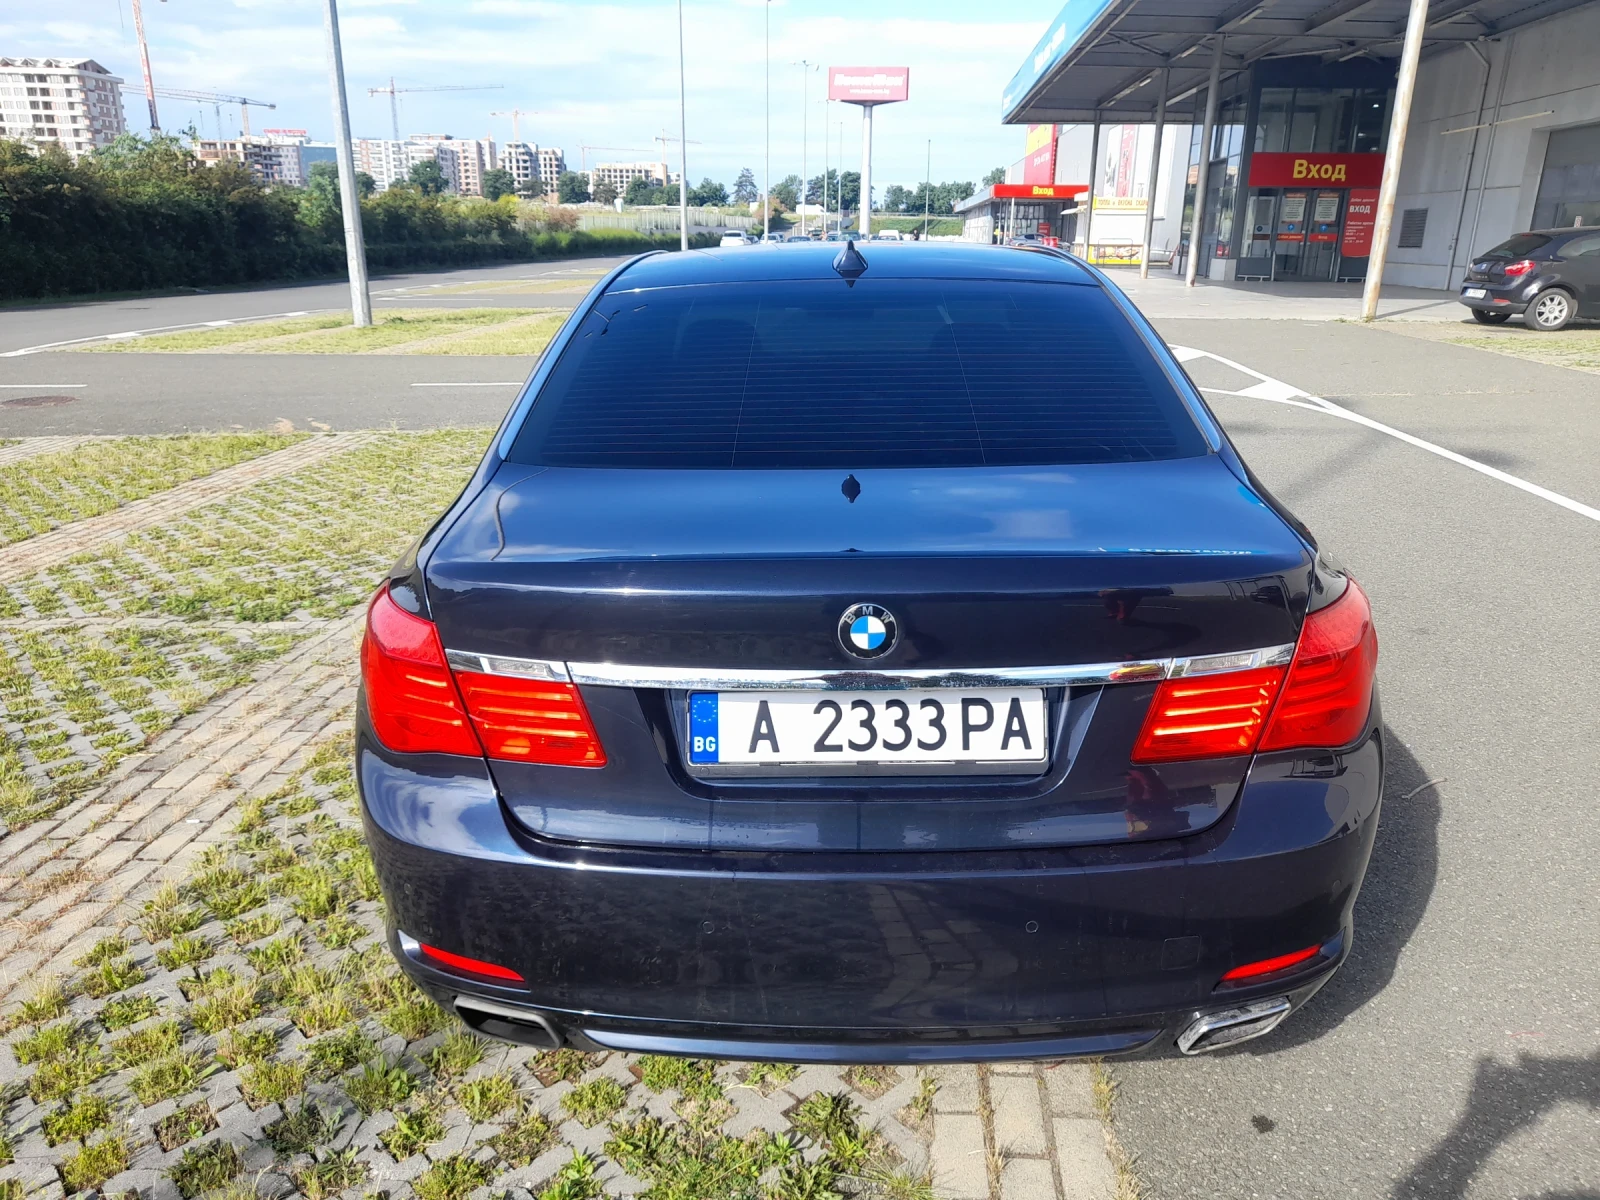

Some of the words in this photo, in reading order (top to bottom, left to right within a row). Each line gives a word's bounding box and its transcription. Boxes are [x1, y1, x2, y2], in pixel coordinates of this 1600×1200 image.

[1292, 159, 1346, 182] Вход
[1032, 185, 1054, 196] Вход
[1349, 205, 1371, 214] ВХОД
[843, 605, 894, 626] BMW
[748, 699, 780, 753] A
[813, 698, 947, 753] 2333
[960, 697, 1033, 751] PA
[693, 736, 716, 753] BG
